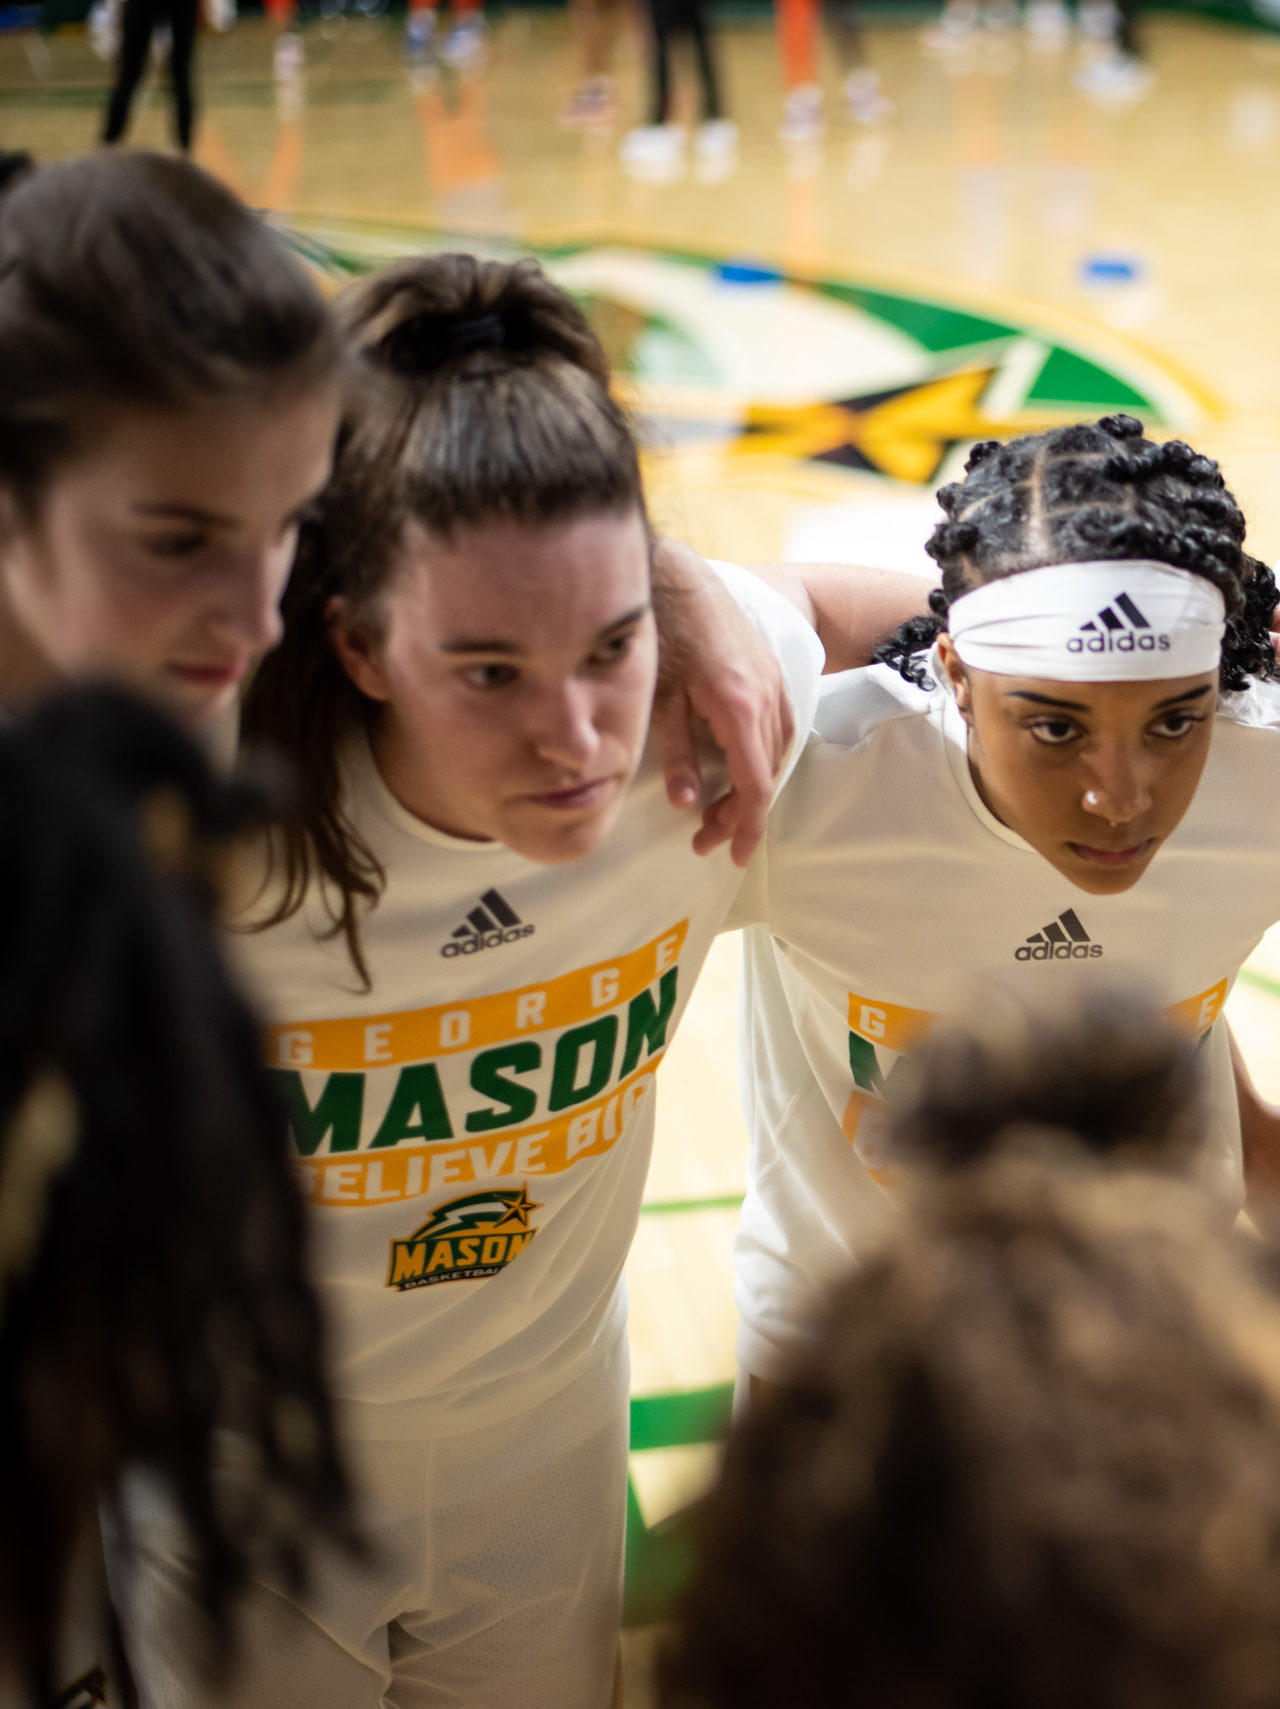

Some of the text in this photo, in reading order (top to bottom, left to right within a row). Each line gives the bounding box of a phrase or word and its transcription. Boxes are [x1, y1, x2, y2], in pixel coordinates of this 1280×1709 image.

[1066, 630, 1170, 653] adidas
[440, 924, 536, 958] adidas
[1014, 940, 1104, 961] adidas
[278, 934, 678, 1065] GEORGE
[266, 965, 679, 1157] MASON
[391, 1232, 532, 1284] MASON
[404, 1267, 499, 1289] BASKETBAL
